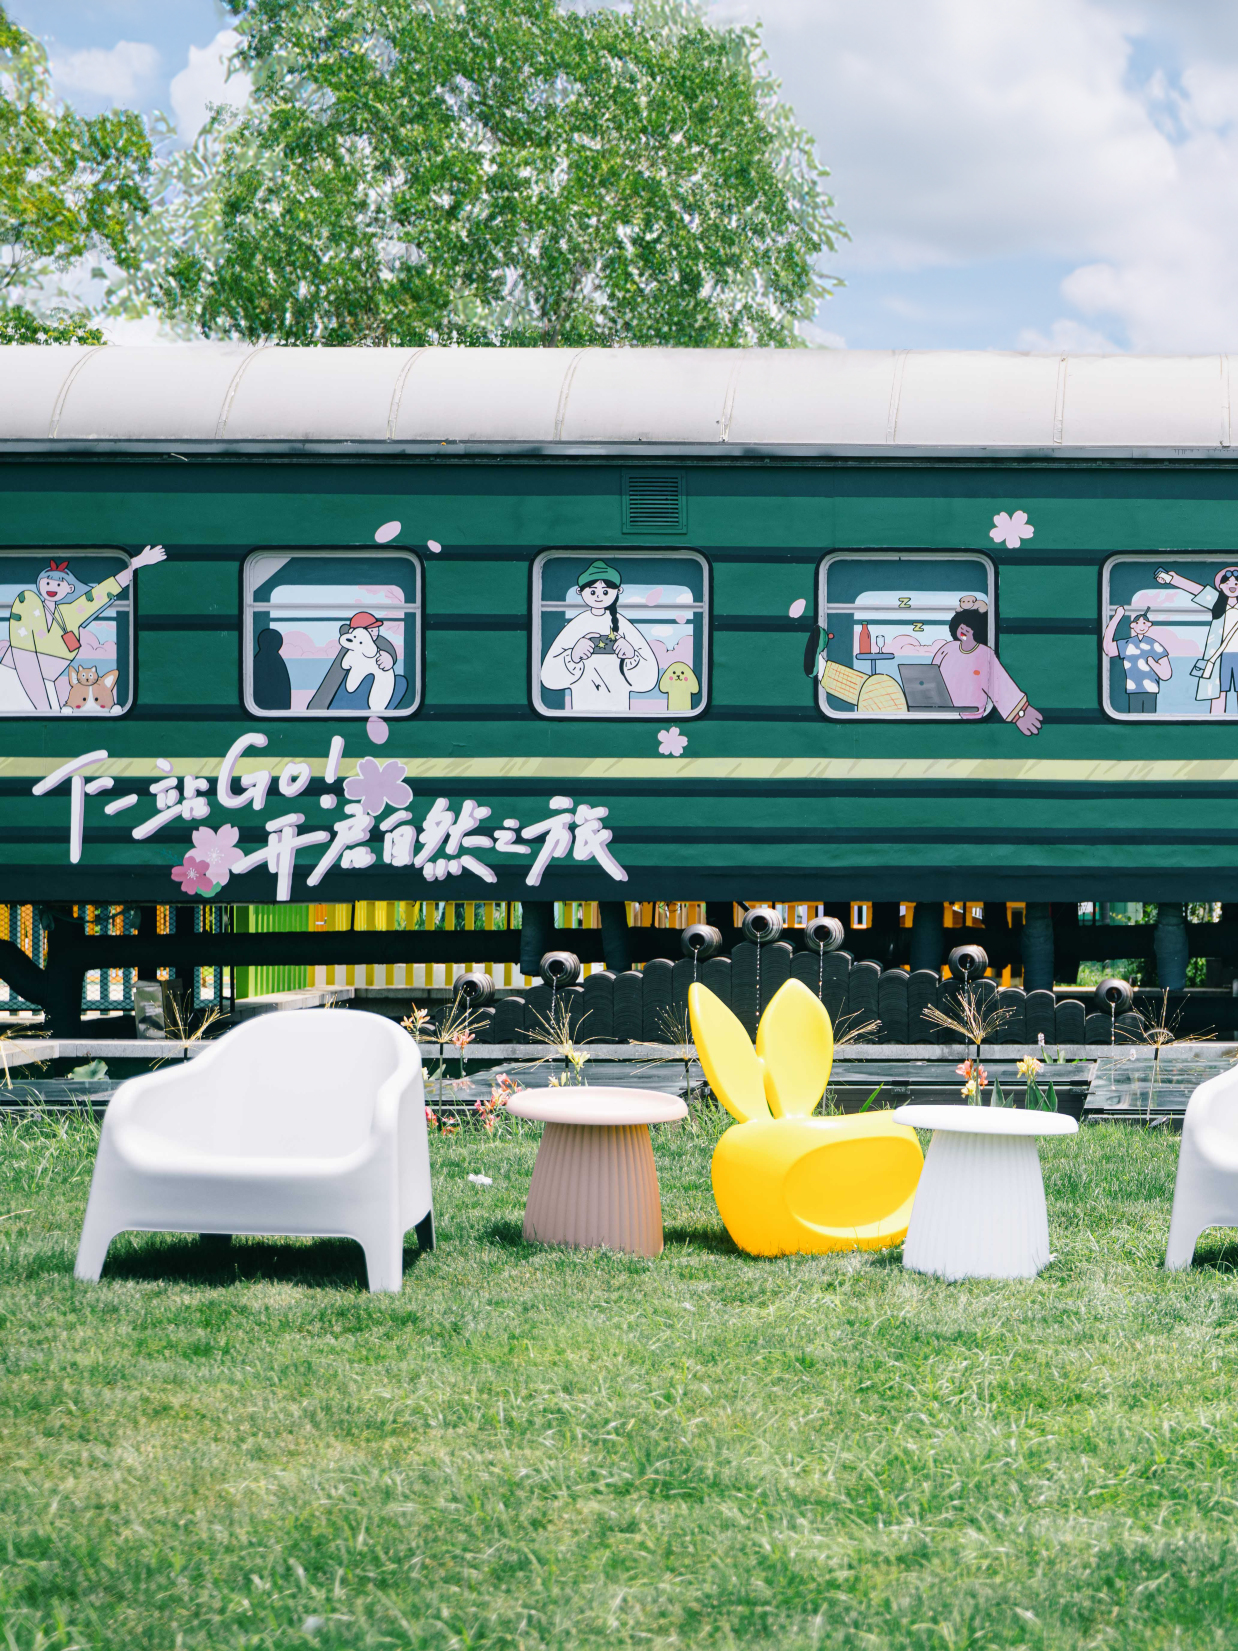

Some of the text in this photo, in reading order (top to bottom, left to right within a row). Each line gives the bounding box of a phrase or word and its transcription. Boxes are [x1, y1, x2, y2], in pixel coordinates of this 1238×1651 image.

[230, 795, 629, 901] 开启自然之旅
